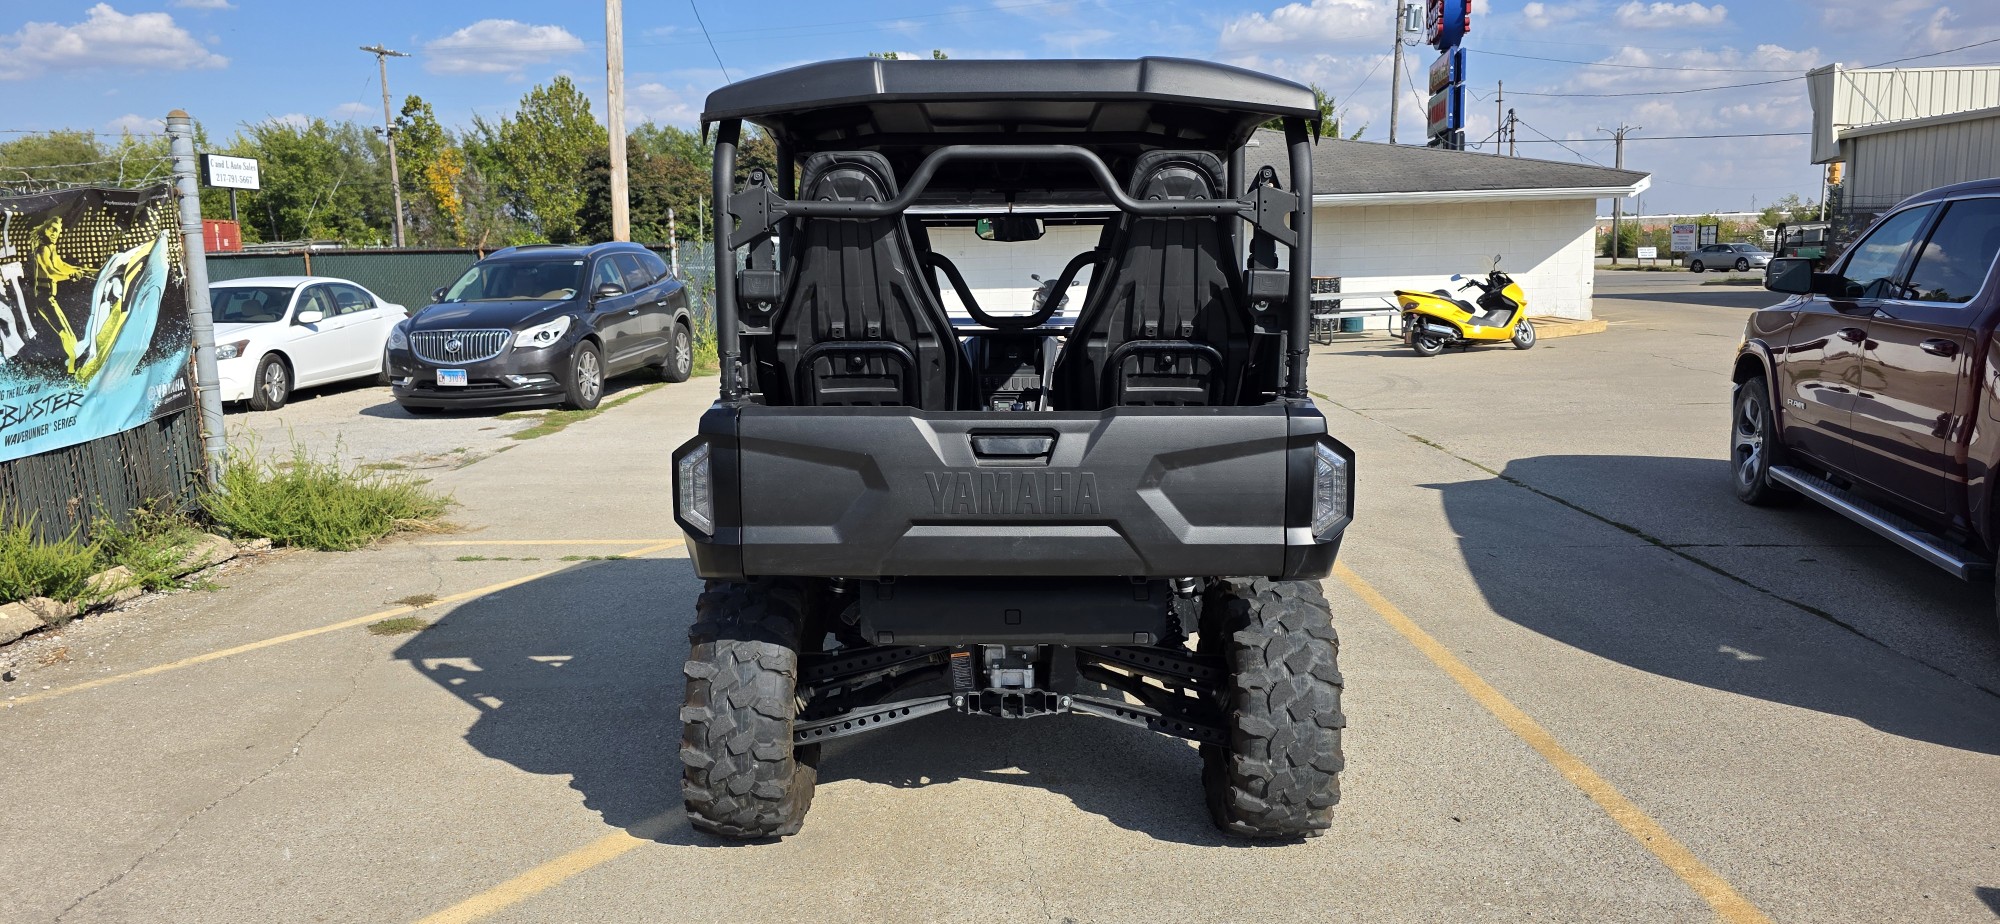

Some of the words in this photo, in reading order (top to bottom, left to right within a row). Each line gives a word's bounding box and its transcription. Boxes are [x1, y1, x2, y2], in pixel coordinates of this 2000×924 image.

[215, 160, 225, 169] and
[230, 161, 242, 170] Auto
[243, 162, 256, 171] Sales
[6, 388, 15, 399] THE
[156, 377, 186, 399] YAMAHA
[0, 392, 84, 432] BLASTER
[1787, 398, 1806, 410] RAM
[53, 416, 77, 432] SERIES
[924, 471, 1101, 515] YAMAHA
